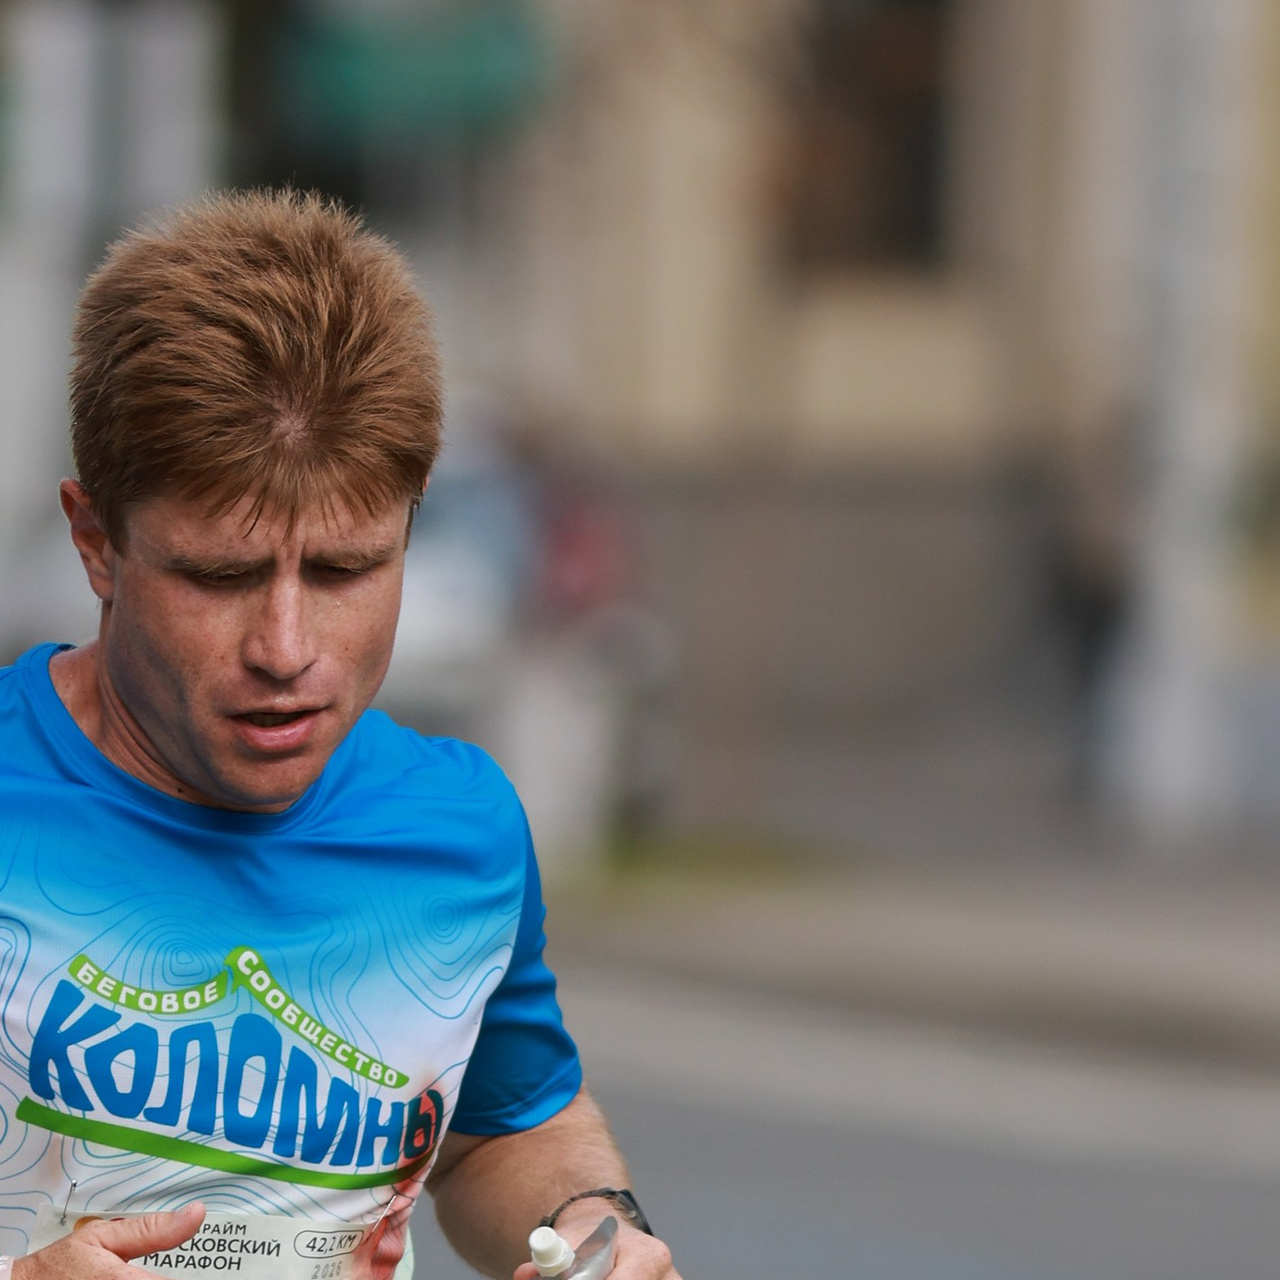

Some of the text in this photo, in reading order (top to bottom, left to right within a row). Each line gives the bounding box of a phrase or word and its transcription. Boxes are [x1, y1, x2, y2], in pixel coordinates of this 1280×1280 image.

[76, 950, 398, 1087] БЕГОВОЕ СООБЩЕСТВО
[29, 979, 445, 1168] КОЛОМНЫ
[199, 1221, 247, 1236] РАЙМ
[178, 1237, 281, 1258] СКОВСКИЙ
[143, 1252, 242, 1271] МАРАФОН
